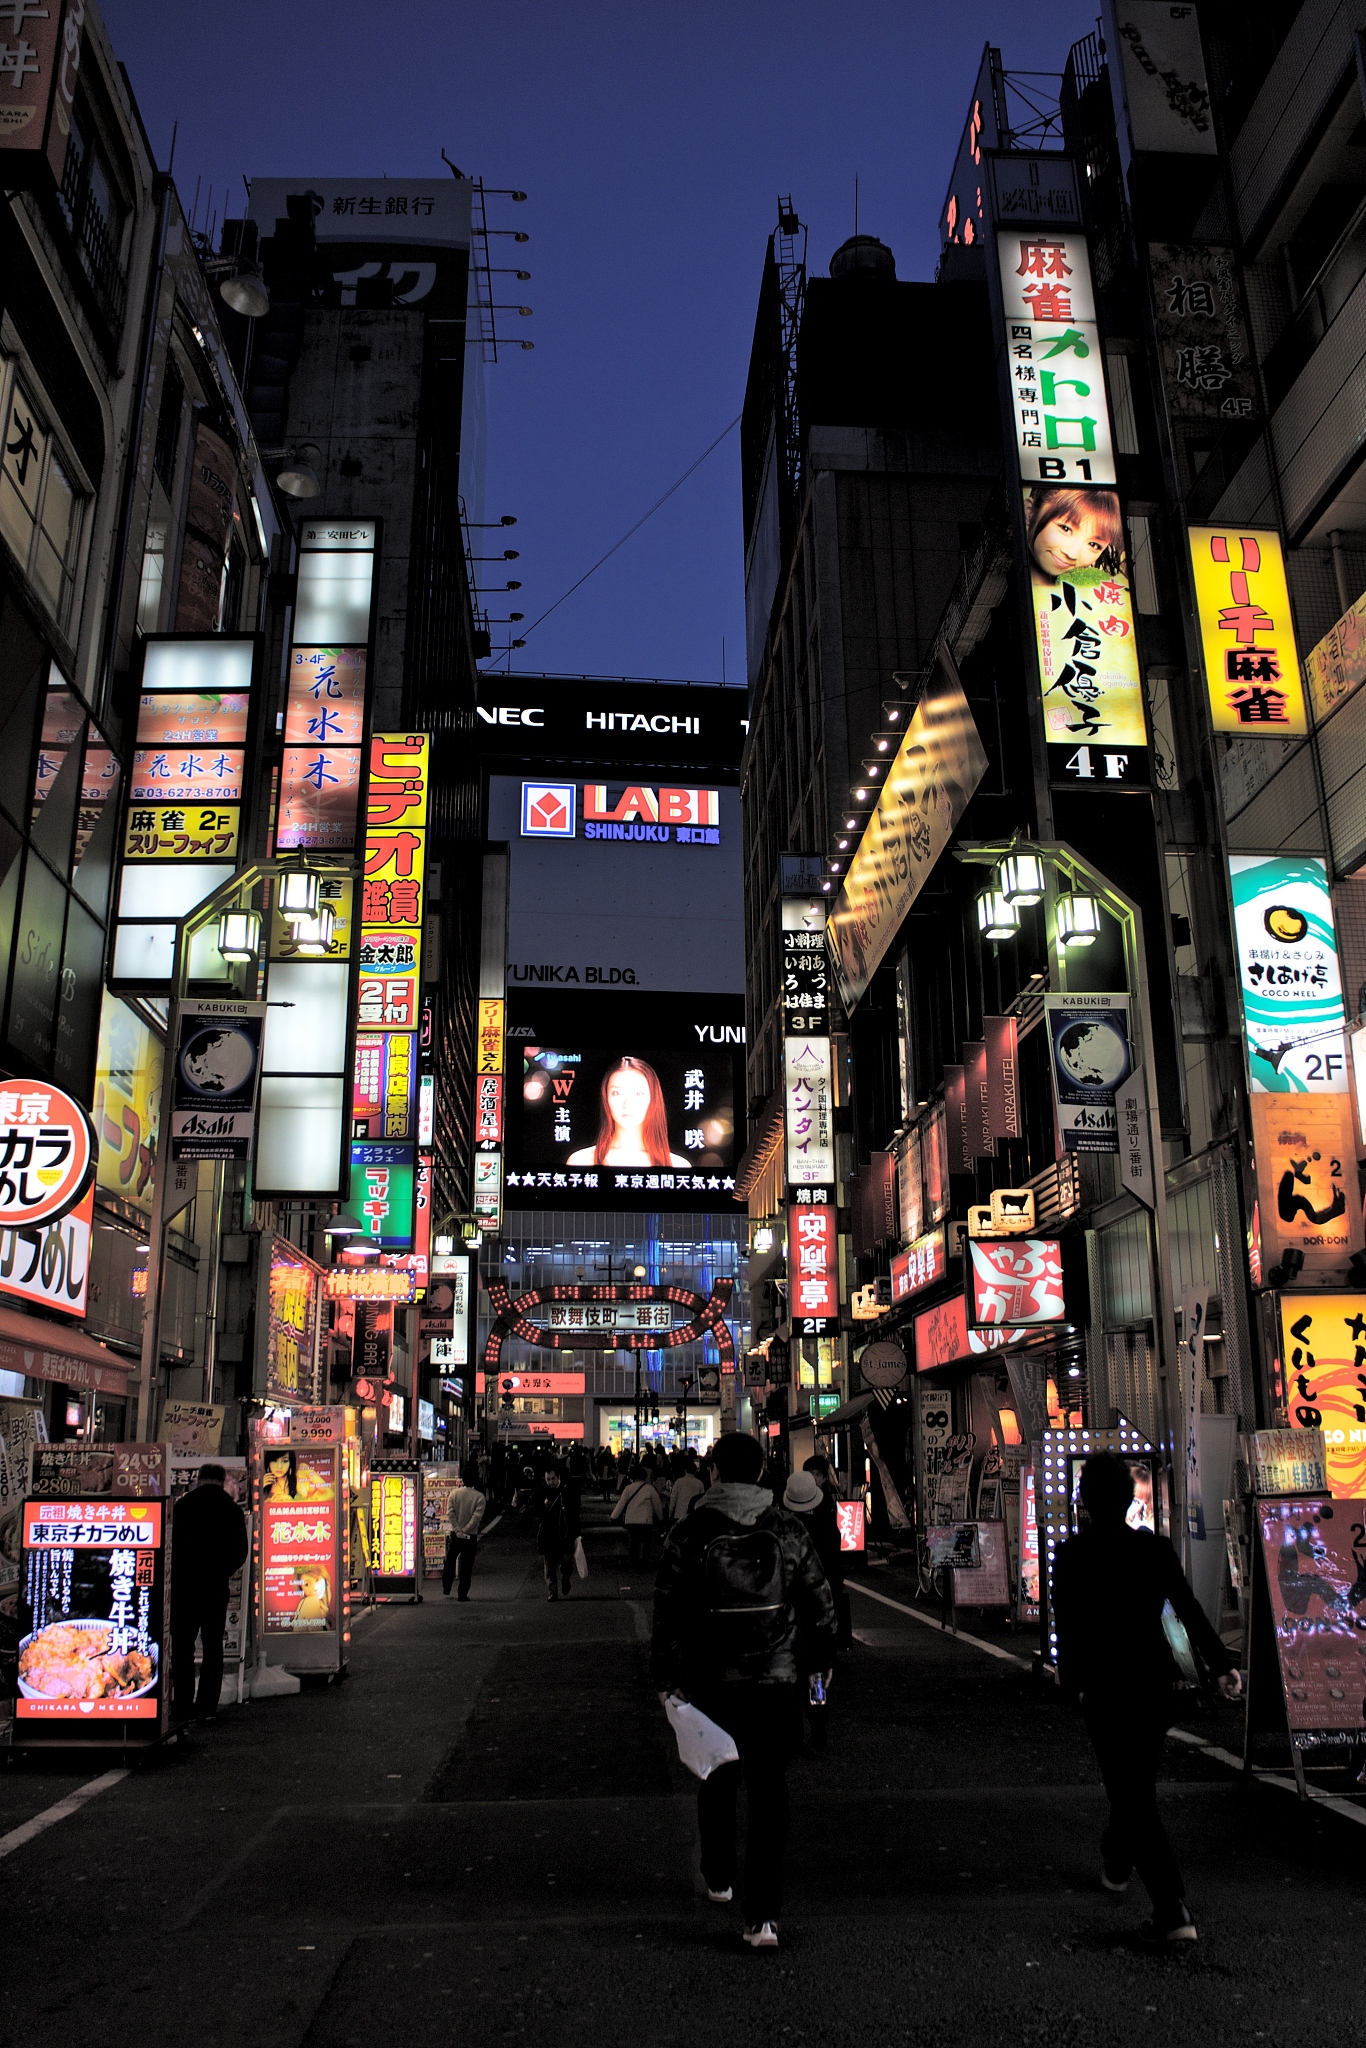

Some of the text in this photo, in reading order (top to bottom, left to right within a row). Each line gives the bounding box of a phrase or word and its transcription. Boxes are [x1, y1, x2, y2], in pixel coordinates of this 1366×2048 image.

[1170, 7, 1191, 19] 6F
[332, 196, 436, 217] 新生銀行
[1016, 240, 1075, 324] 麻雀
[1166, 276, 1232, 389] 相膳
[1010, 325, 1041, 448] 四名様専門店
[1036, 328, 1097, 452] メトロ
[1221, 397, 1252, 416] 4F
[1038, 456, 1094, 481] B1
[306, 528, 370, 542] 第二安田ビル
[1092, 578, 1130, 638] 焼肉
[1210, 535, 1291, 725] リーチ麻雀
[1038, 610, 1054, 676] 新宿歌舞伎町店
[1044, 581, 1112, 737] 小倉優子
[141, 696, 154, 706] 4F
[150, 702, 243, 716] リラクゼーション
[178, 714, 212, 726] サロン
[301, 665, 345, 791] 花水木
[476, 706, 700, 735] NEC HITACHI
[163, 729, 219, 742] 24H営業
[135, 752, 236, 779] 3F 花水木
[346, 755, 359, 787] サロン
[1065, 746, 1128, 779] 4F
[146, 787, 239, 799] 03-6273-8701
[284, 754, 298, 819] ハナミズキ
[364, 735, 425, 877] ビデオ
[583, 783, 720, 826] LABI
[130, 810, 230, 832] 麻雀 2F
[291, 820, 343, 833] 24H営業
[584, 822, 671, 843] SHINJUKU
[127, 832, 235, 856] スリーファイブ
[361, 879, 421, 924] 鑑賞
[784, 932, 825, 949] 小料理
[360, 944, 415, 965] 金太郎
[374, 965, 397, 973] グループ
[586, 965, 641, 985] BLDG.
[1248, 961, 1328, 989] さしあげ亭
[360, 980, 410, 1003] 2F
[1262, 989, 1317, 998] COCO NEEL
[358, 1003, 409, 1024] 受付
[791, 1015, 823, 1030] 3F
[480, 1001, 501, 1071] フリー麻雀さん
[557, 1053, 582, 1063] asahi
[1305, 1053, 1343, 1081] 2F
[481, 1078, 498, 1127] 居酒屋
[1004, 1057, 1018, 1135] ANRAKUTEI
[684, 1069, 705, 1150] 武井 咲
[792, 1077, 815, 1154] バンタイ
[817, 1077, 829, 1147] タイ国料理専門店
[1074, 1107, 1117, 1129] Asah
[182, 1114, 236, 1135] Asahi
[480, 1140, 497, 1150] 4F
[1125, 1097, 1142, 1178] 劇場通り一番街
[352, 1147, 405, 1155] オンライン
[802, 1171, 820, 1181] 3F
[1329, 1160, 1343, 1177] 2
[537, 1172, 706, 1191] 天気予報 東京週間天気
[363, 1167, 390, 1234] ラッキー
[796, 1188, 828, 1204] 焼肉
[797, 1211, 830, 1310] 安楽亭
[425, 1319, 447, 1329] Asahi
[551, 1306, 670, 1327] 歌舞伎町一番街
[802, 1318, 827, 1334] 2F
[363, 1341, 378, 1366] BAR
[876, 1359, 907, 1370] James
[42, 1351, 90, 1384] 東京チカラめし
[439, 1363, 456, 1374] 2F
[1289, 1314, 1322, 1428] くいもの
[164, 1413, 220, 1429] スリーファイブ
[174, 1404, 214, 1417] リーチ麻雀
[304, 1416, 331, 1424] 13,000
[301, 1428, 332, 1439] 9,990
[41, 1452, 91, 1466] 焼き牛丼
[117, 1473, 161, 1487] OPEN
[41, 1504, 127, 1521] 元祖 焼き牛丼
[269, 1506, 330, 1516] HANAMIZUKI
[33, 1524, 150, 1543] 東京チカラめし
[270, 1521, 332, 1545] 花水木
[49, 1548, 61, 1600] 旨いんです。
[138, 1551, 154, 1585] 元祖
[61, 1548, 74, 1615] 焼いているから
[108, 1549, 137, 1657] 焼き牛丼
[136, 1585, 149, 1657] これぞ真の肉丼。
[30, 1704, 140, 1712] CHIKARA MESHI
